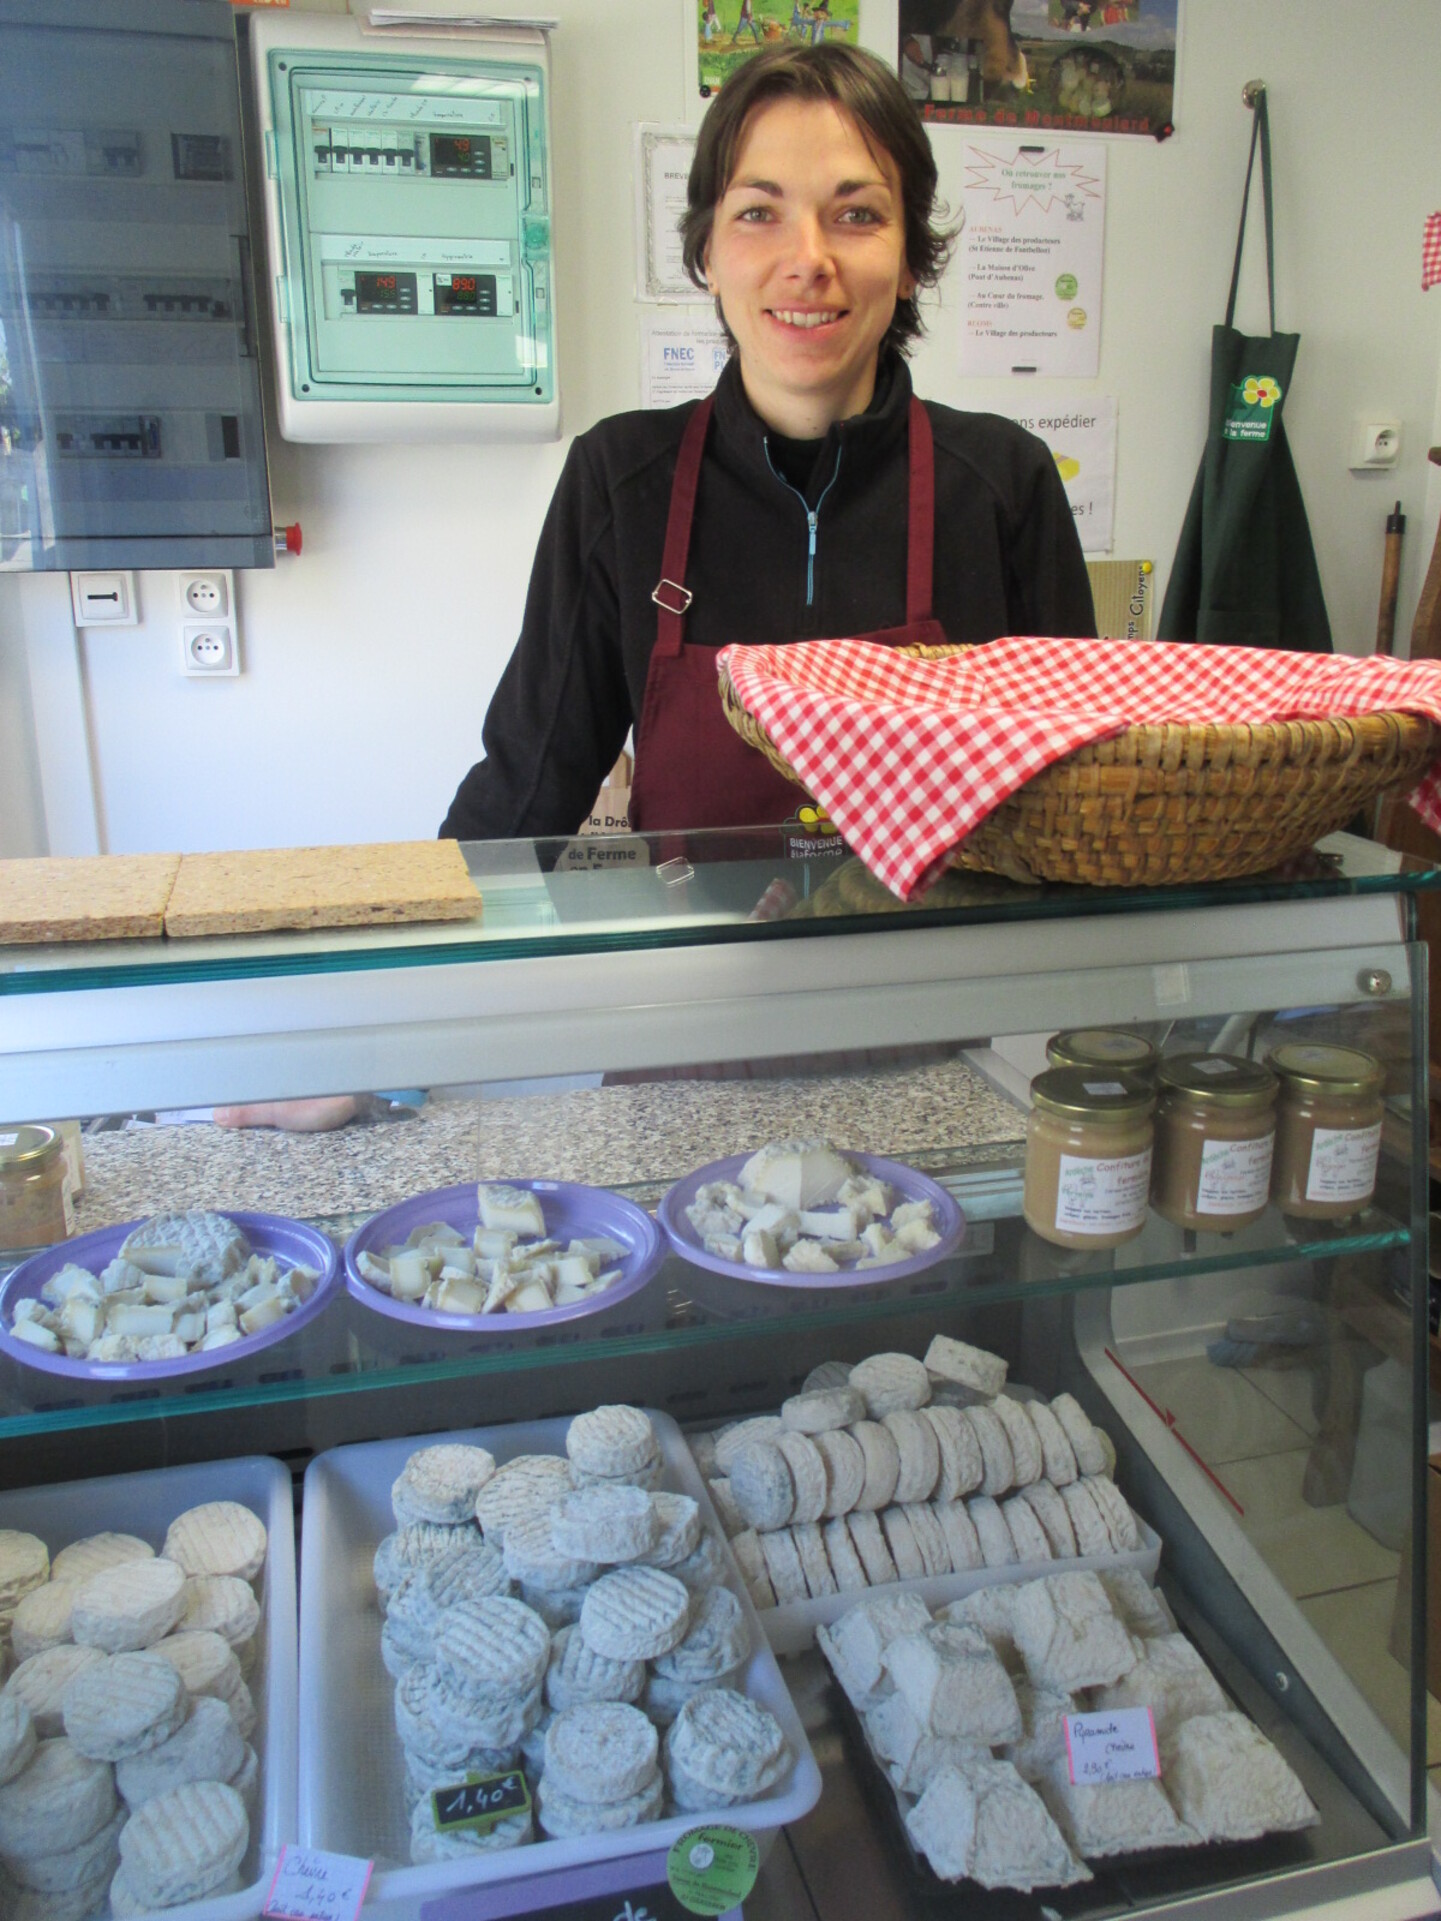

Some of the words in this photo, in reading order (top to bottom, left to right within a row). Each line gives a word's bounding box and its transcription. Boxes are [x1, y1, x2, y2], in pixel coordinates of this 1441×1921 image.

[923, 104, 987, 122] Ferme
[994, 108, 1017, 123] de
[663, 347, 695, 360] FNEC
[1038, 414, 1097, 431] expédier
[1240, 429, 1266, 438] ferme
[790, 836, 843, 850] BIENVENUE
[567, 848, 584, 860] de
[587, 847, 637, 860] Ferme
[698, 1831, 743, 1850] fermier
